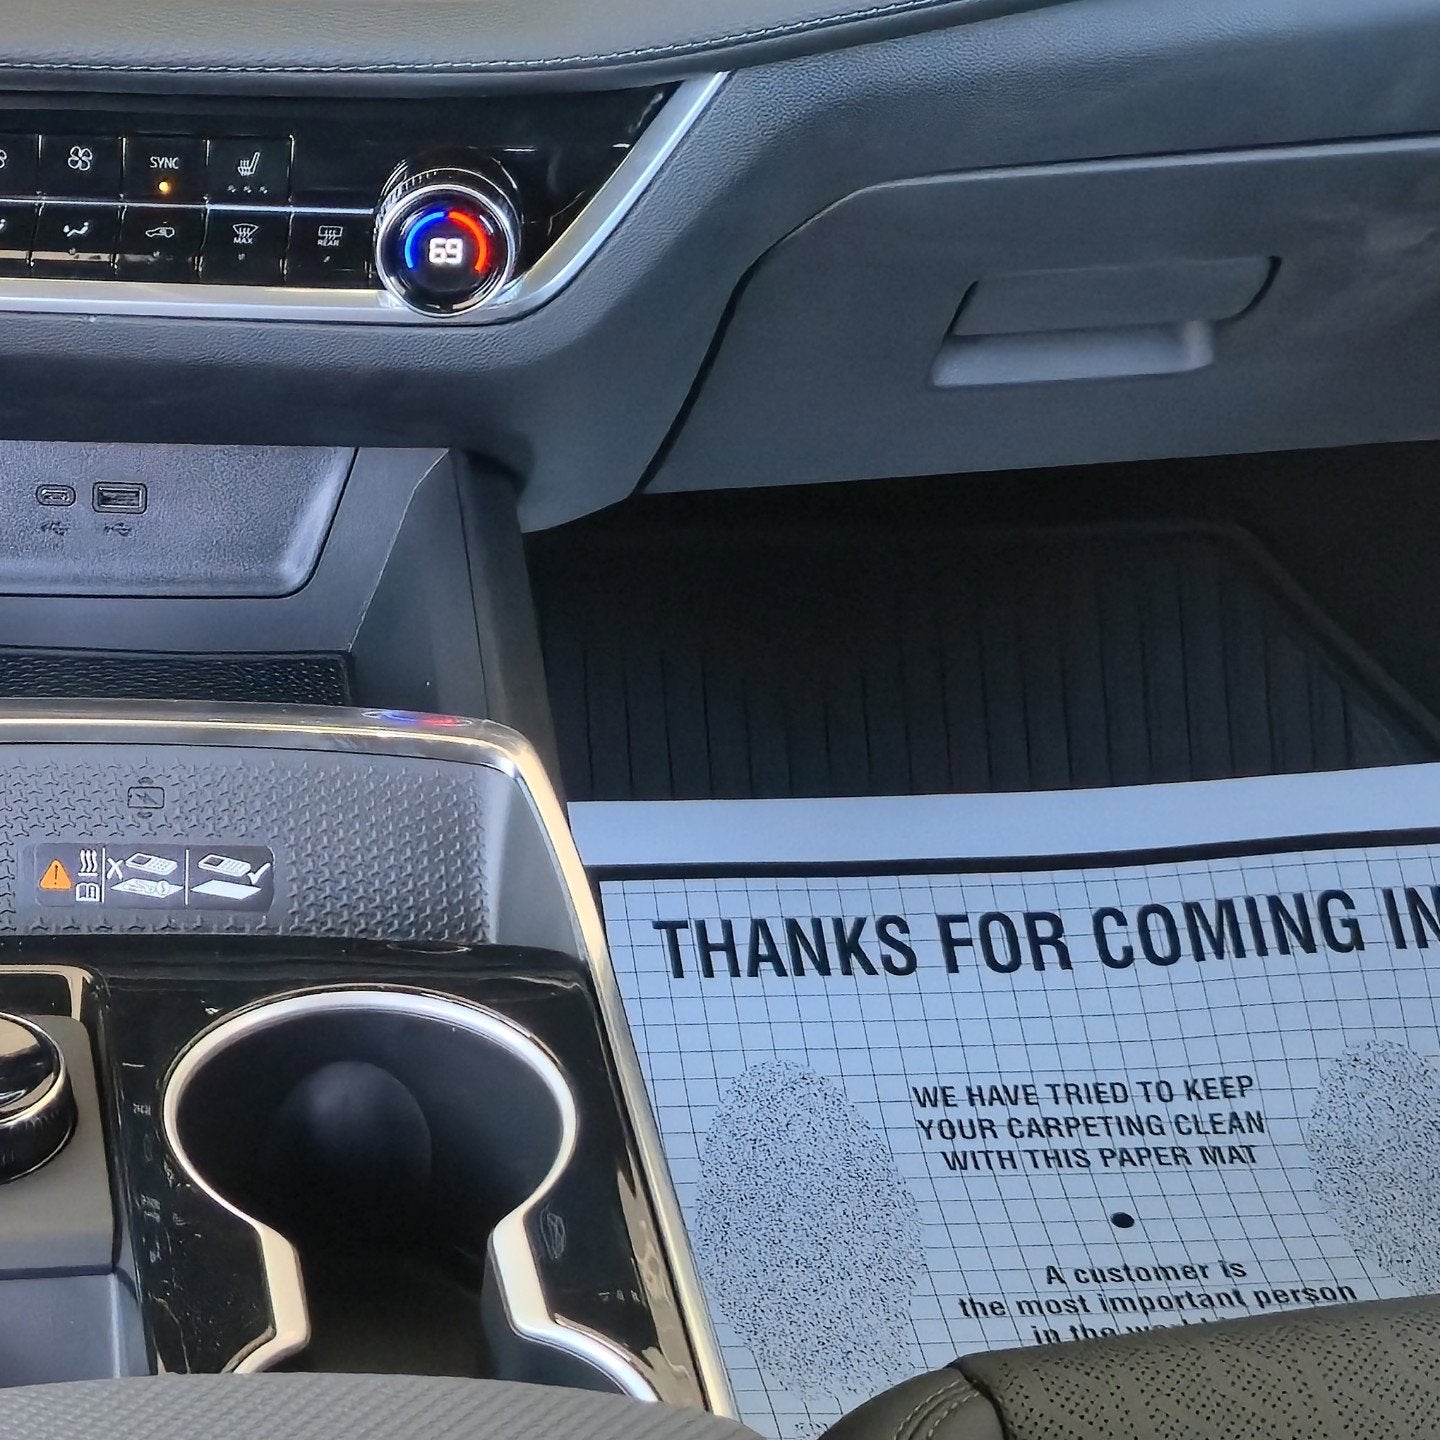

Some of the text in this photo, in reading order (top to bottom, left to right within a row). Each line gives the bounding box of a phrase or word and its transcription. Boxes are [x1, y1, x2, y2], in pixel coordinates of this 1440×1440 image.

[149, 156, 180, 171] SYNC
[232, 235, 254, 245] MAX
[317, 237, 341, 247] REAR
[653, 914, 917, 979] THANKS
[938, 912, 1072, 974] FOR
[1093, 888, 1356, 969] COMING
[912, 1075, 1253, 1108] WE HAVE TRIED TO KEEP
[916, 1111, 1265, 1141] YOUR CARPETING CLEAN
[940, 1144, 1259, 1171] WITH THIS PAPER MAT
[1046, 1261, 1248, 1284] A customer is
[959, 1286, 1358, 1318] the most important person
[1031, 1325, 1060, 1344] in
